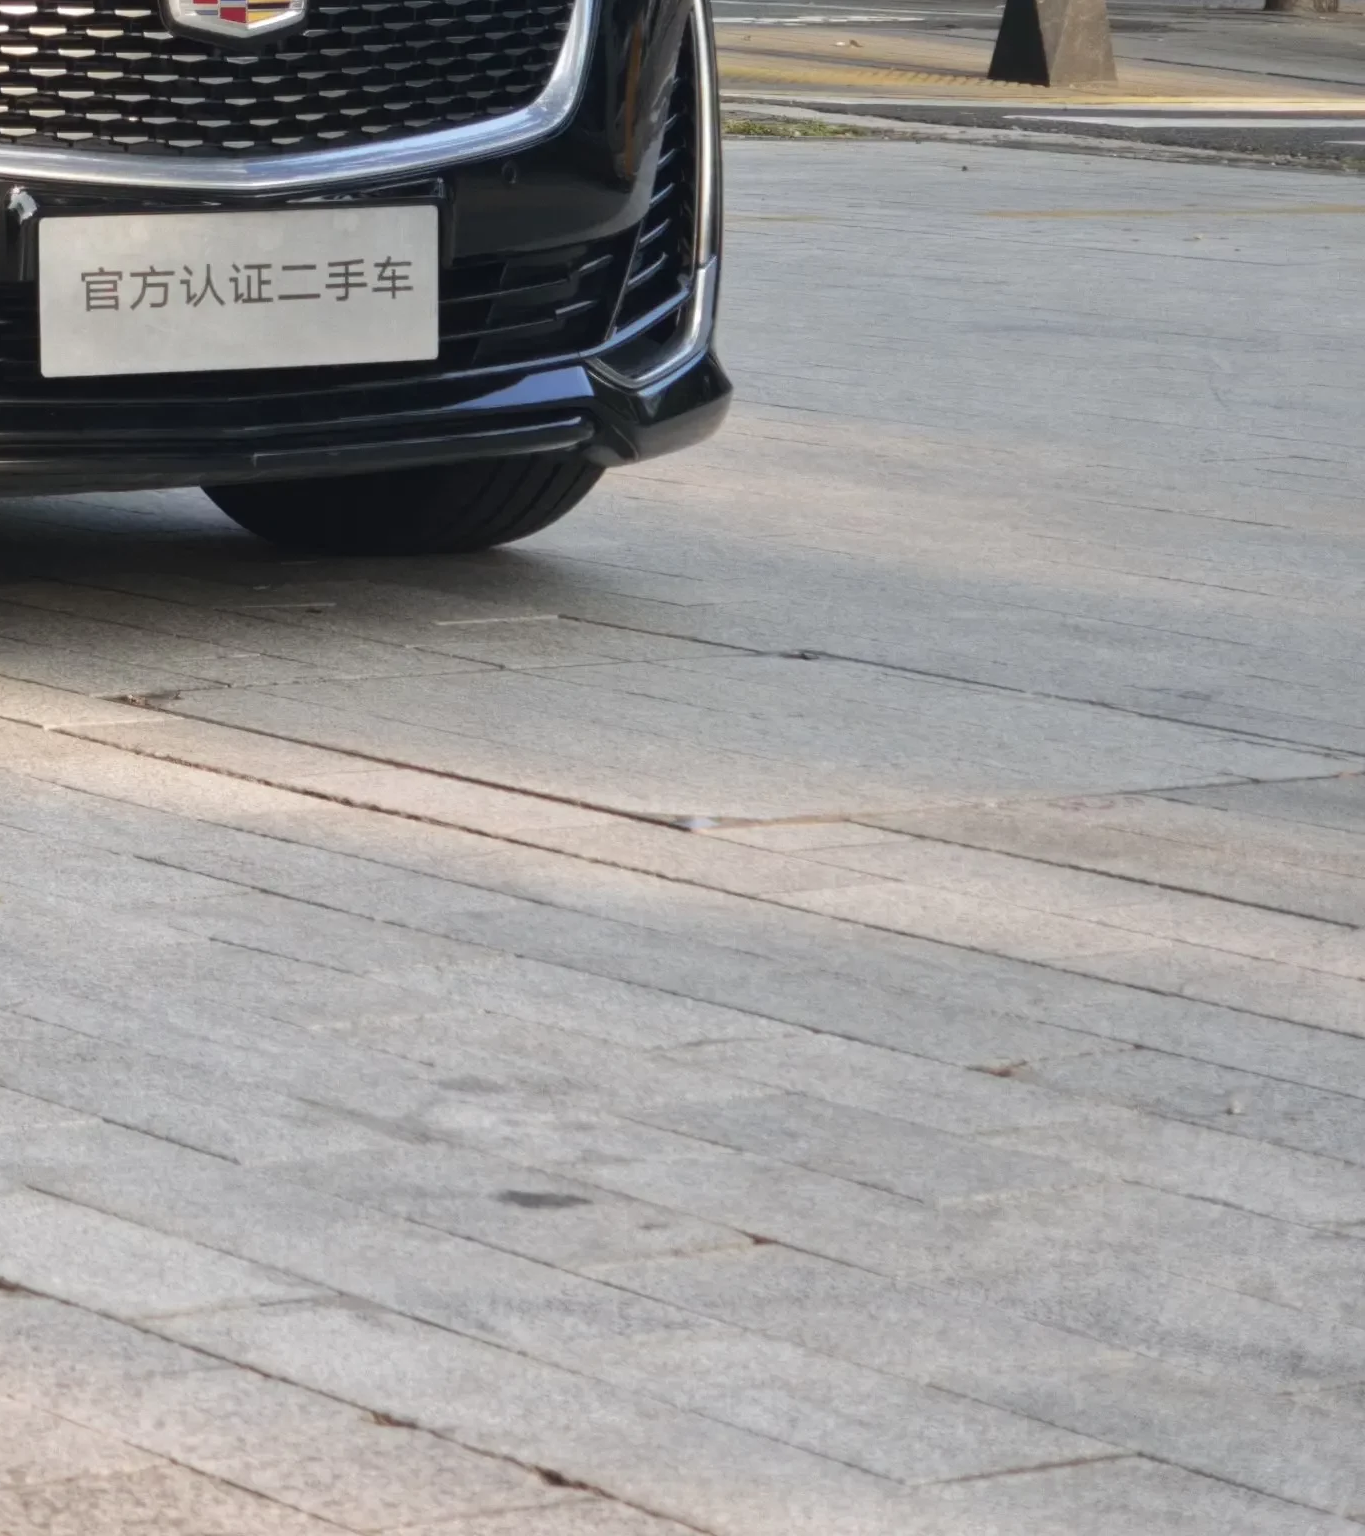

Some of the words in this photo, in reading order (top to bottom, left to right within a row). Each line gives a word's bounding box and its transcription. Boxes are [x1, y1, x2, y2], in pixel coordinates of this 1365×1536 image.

[80, 255, 414, 312] 官方认证二手车
